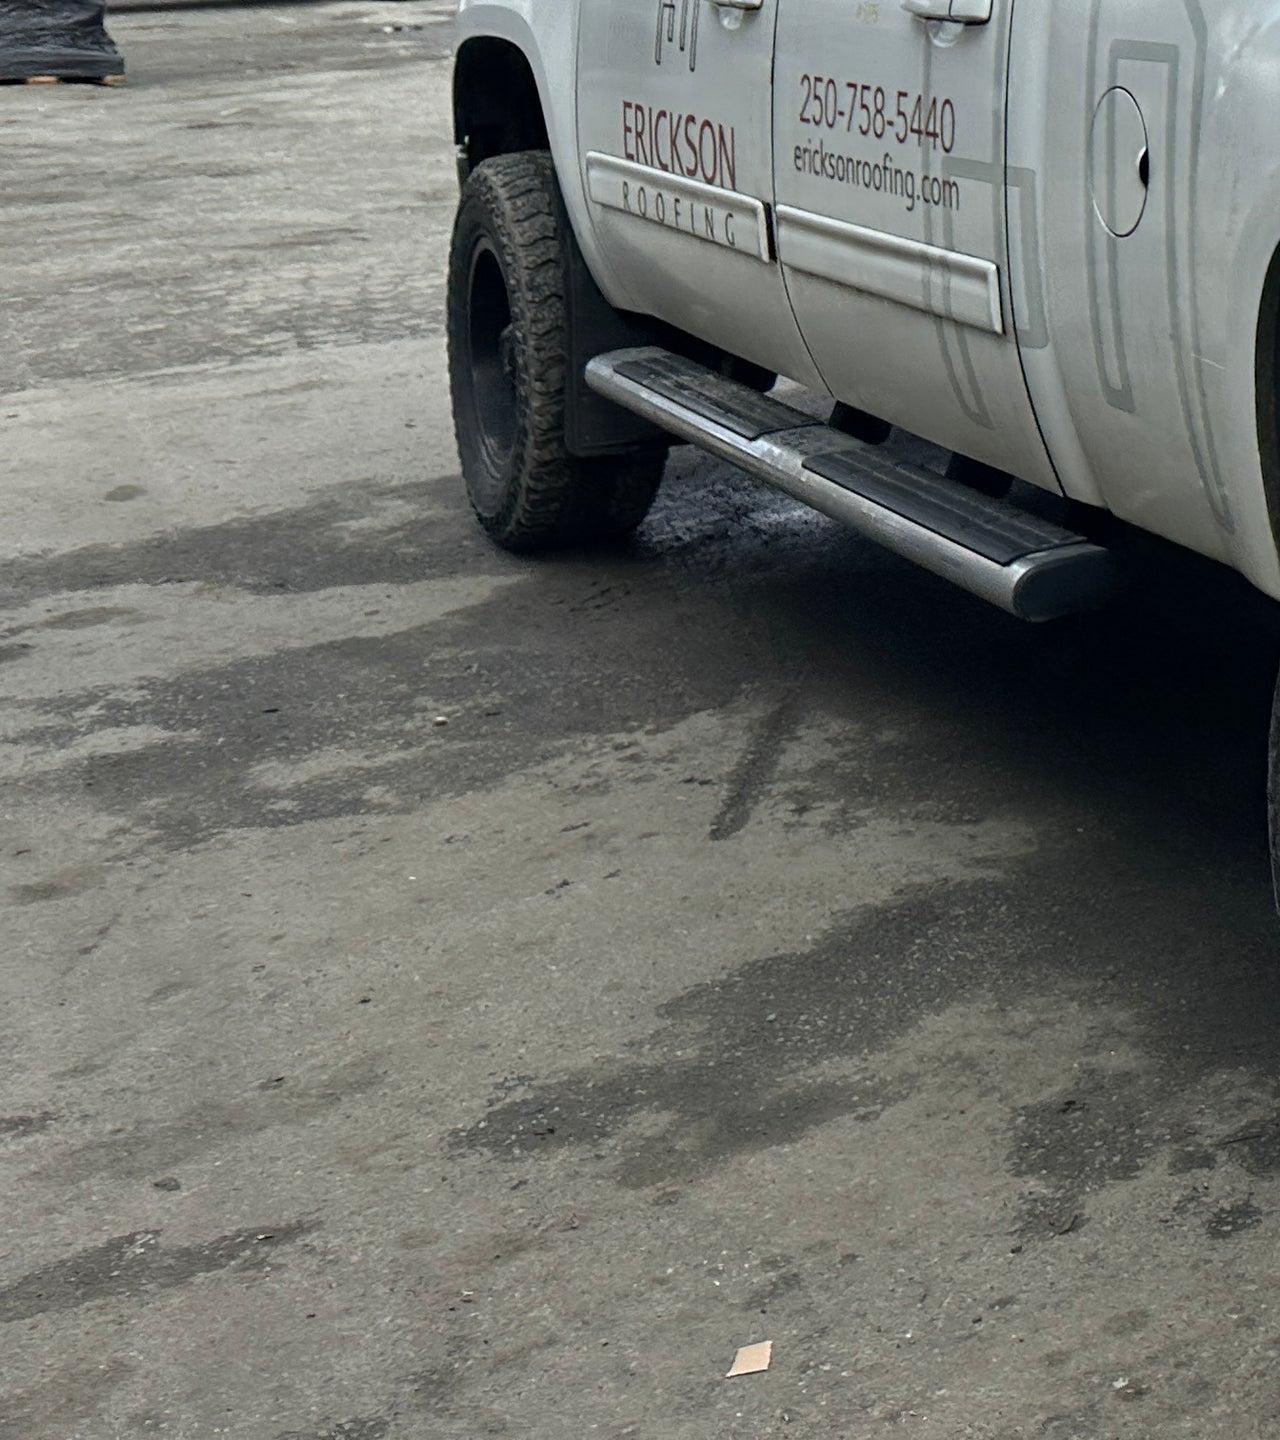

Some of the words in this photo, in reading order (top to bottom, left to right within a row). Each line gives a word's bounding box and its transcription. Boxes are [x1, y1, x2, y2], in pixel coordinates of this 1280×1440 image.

[622, 99, 737, 192] ERICKSON
[799, 73, 955, 154] 250-758-5440
[623, 180, 737, 247] ROOFING
[793, 141, 960, 212] ericksonroofing.com
